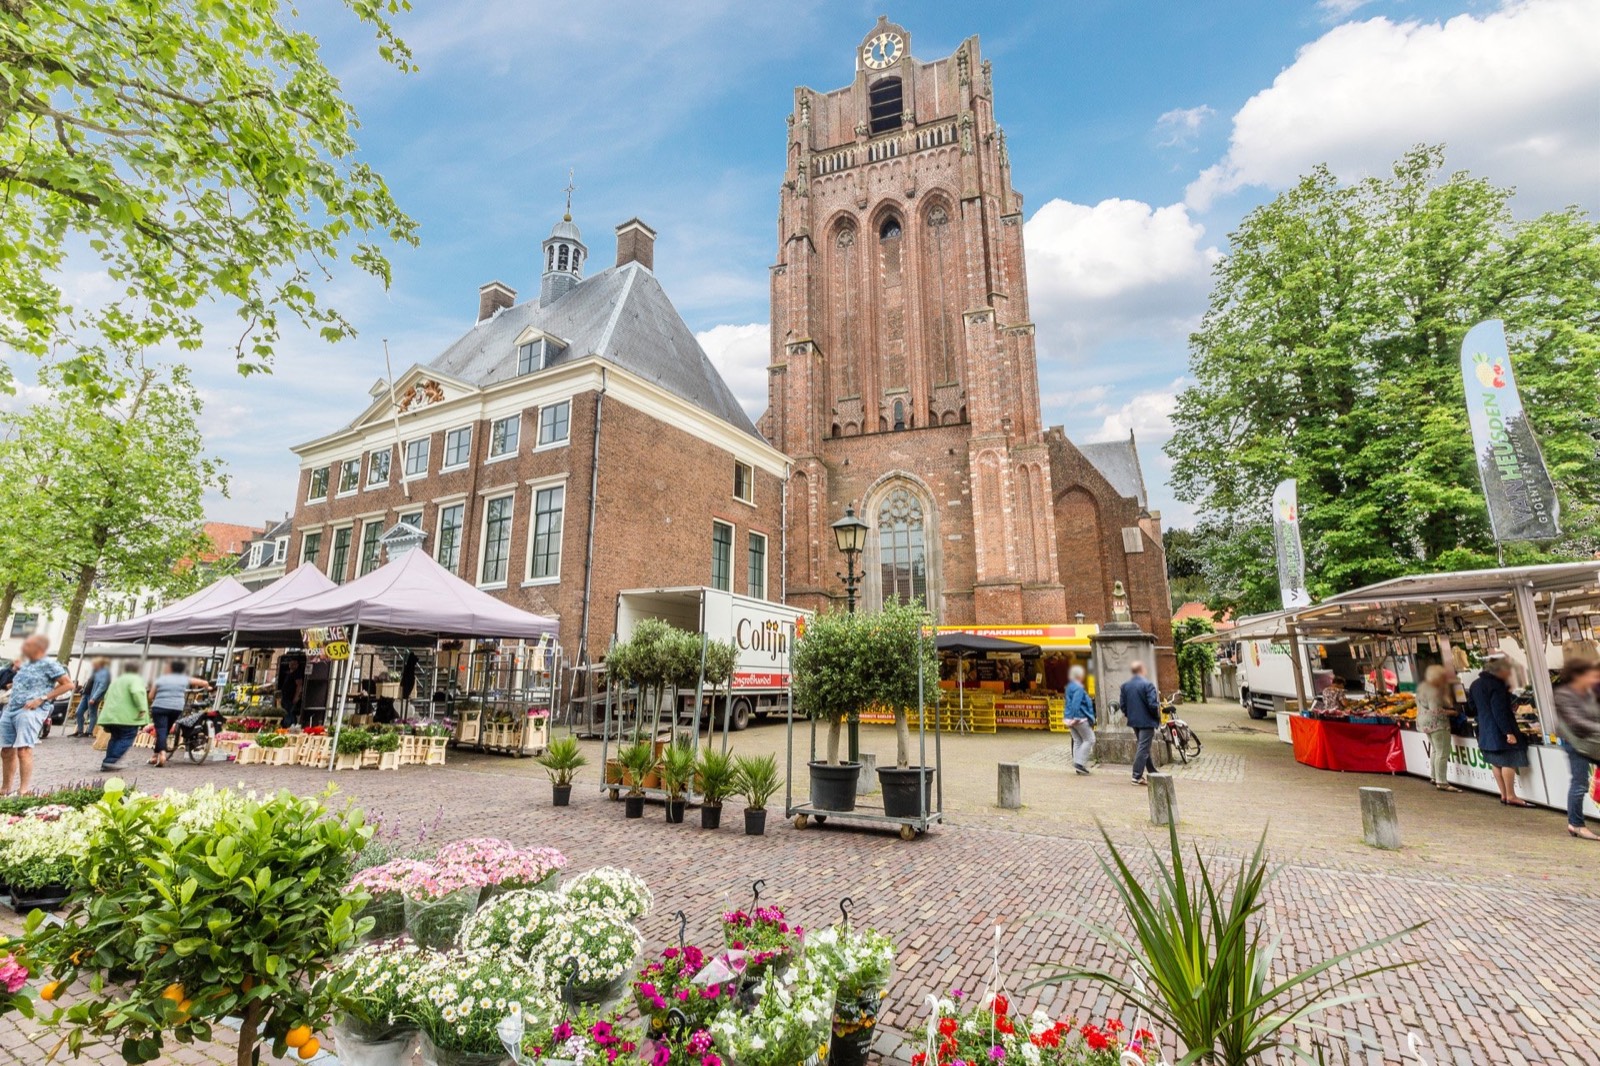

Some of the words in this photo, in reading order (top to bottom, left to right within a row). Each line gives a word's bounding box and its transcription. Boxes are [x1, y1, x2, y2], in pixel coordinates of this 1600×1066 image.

[1522, 461, 1533, 474] EN
[1526, 479, 1548, 524] GROENTE
[737, 618, 786, 661] Colijn
[996, 710, 1030, 718] BAKKERIJ
